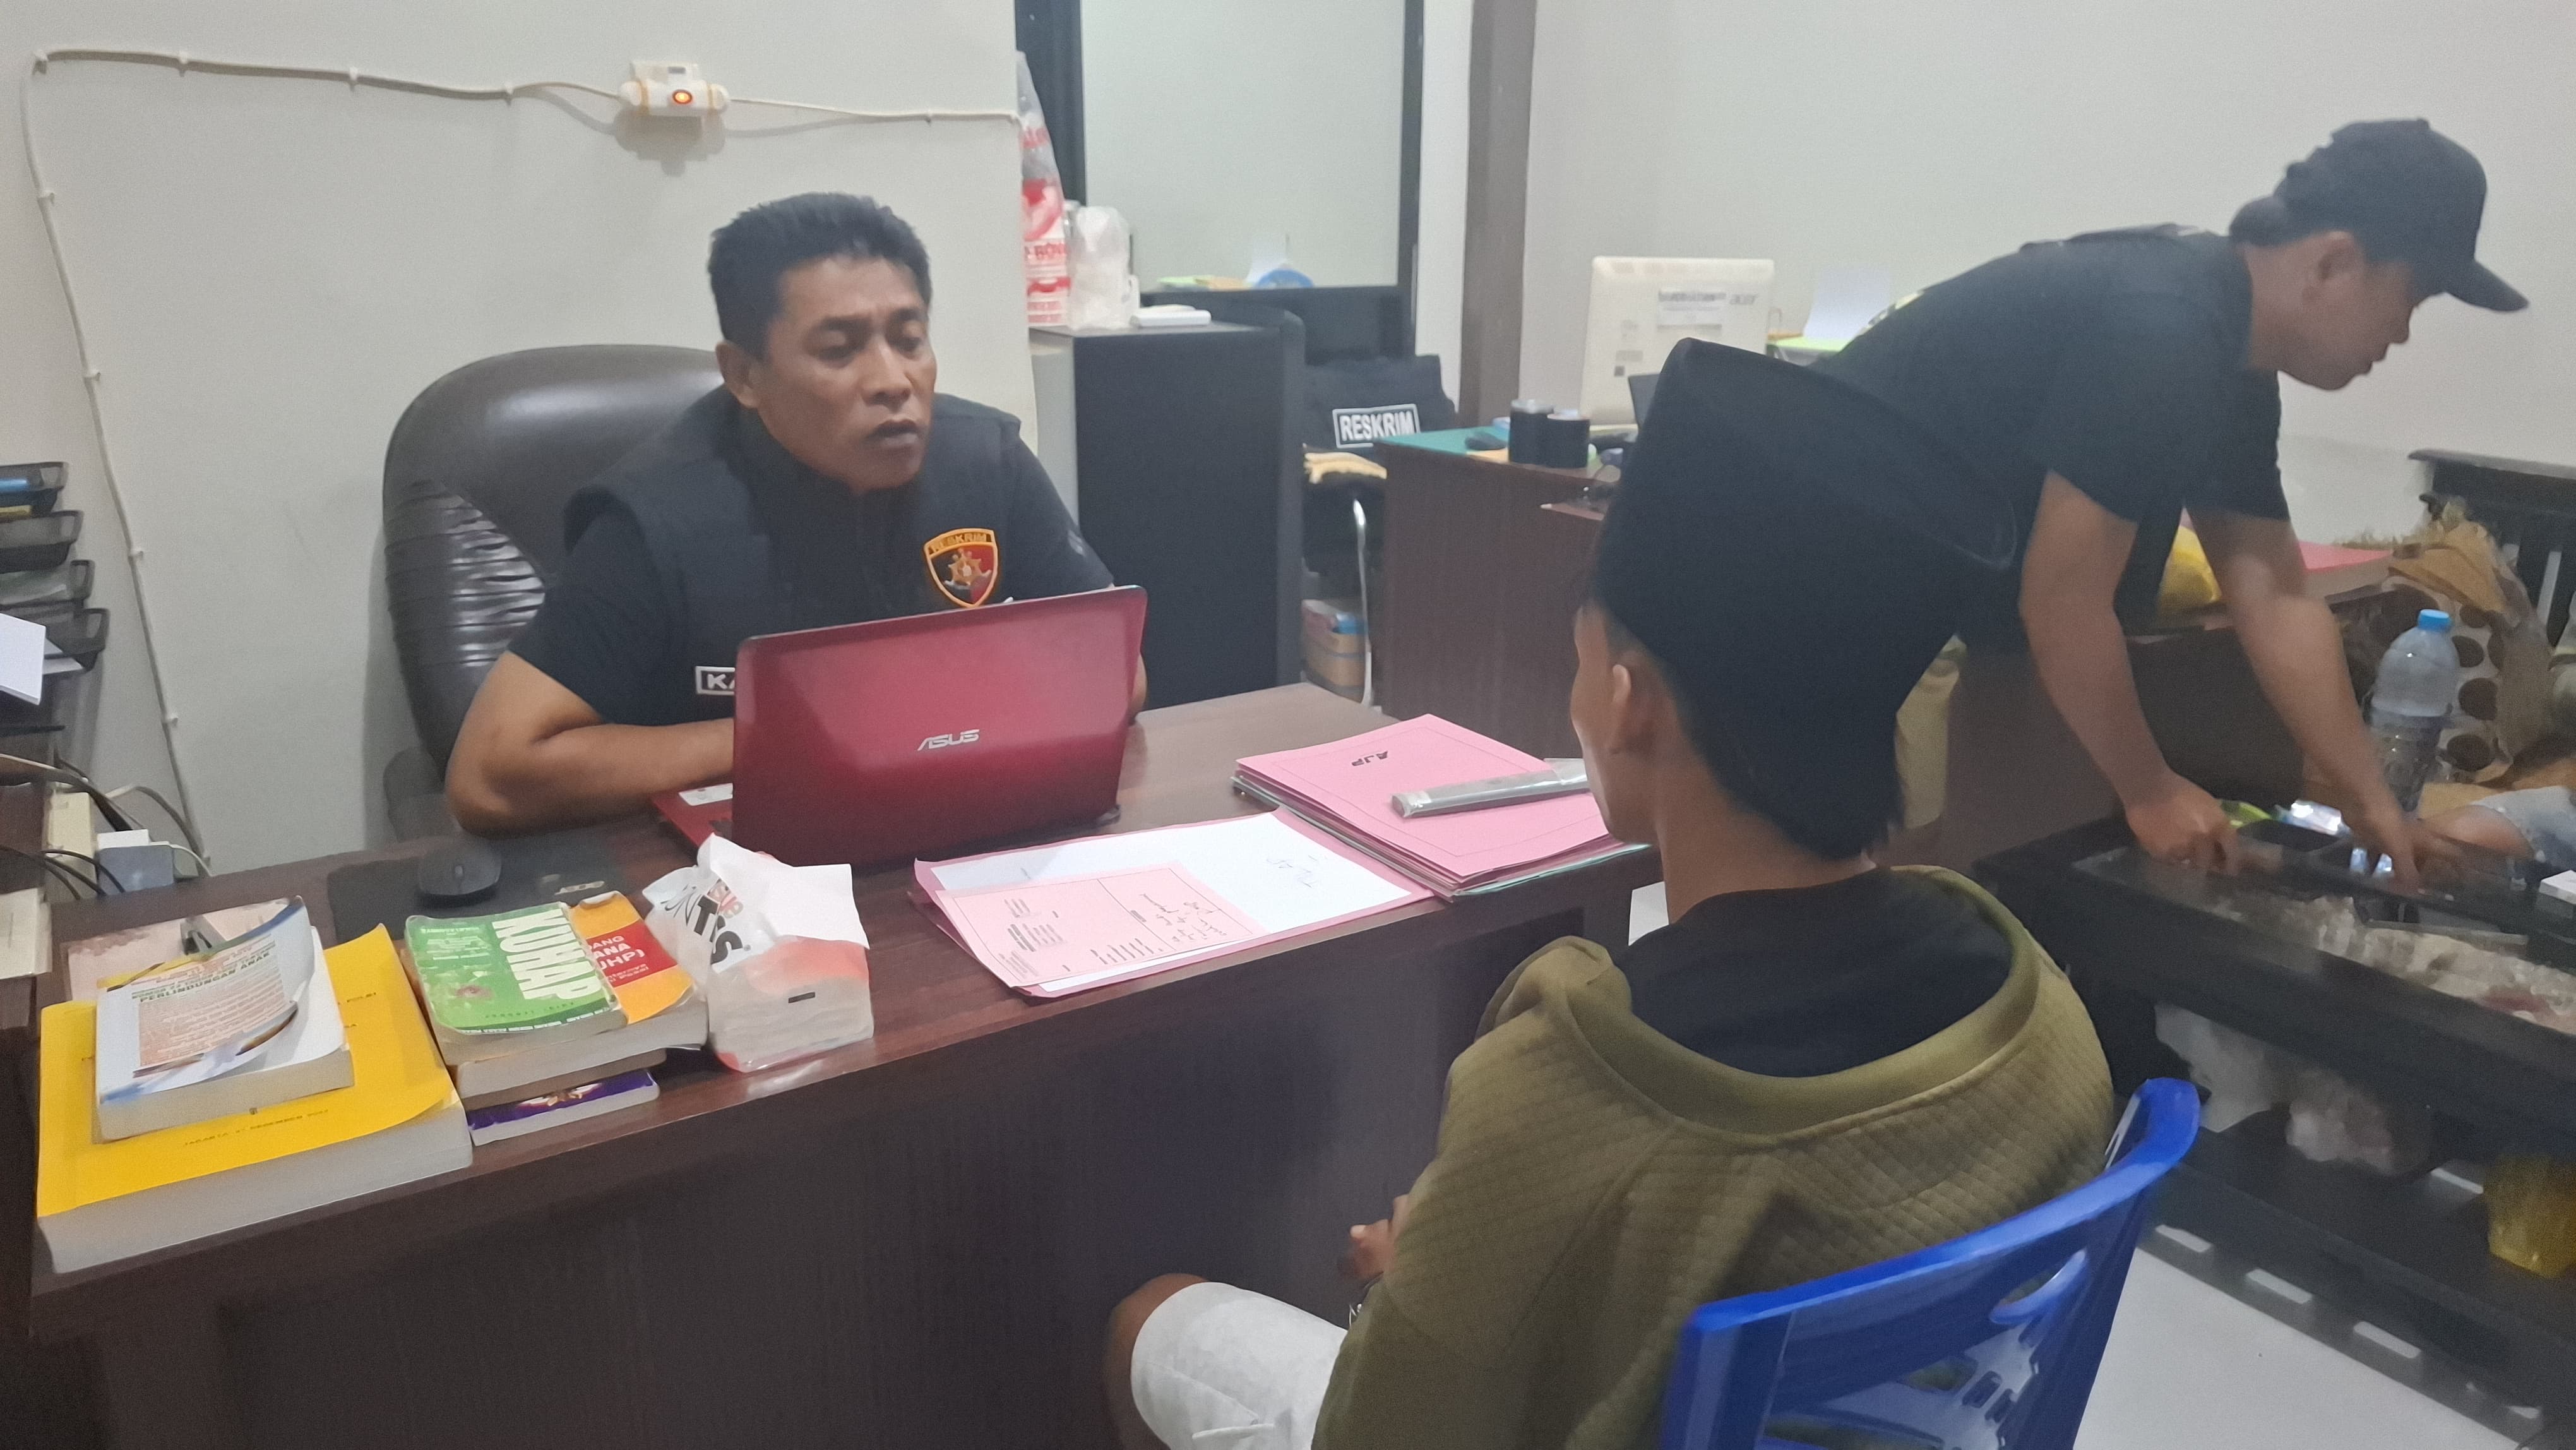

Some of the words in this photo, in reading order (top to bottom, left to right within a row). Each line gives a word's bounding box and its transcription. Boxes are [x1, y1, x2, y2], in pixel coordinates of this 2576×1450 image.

[1340, 410, 1415, 441] RESKRIM
[917, 729, 980, 751] ASUS
[1351, 750, 1388, 766] AJP
[240, 952, 270, 969] ANAK
[492, 909, 602, 1000] KUHAP
